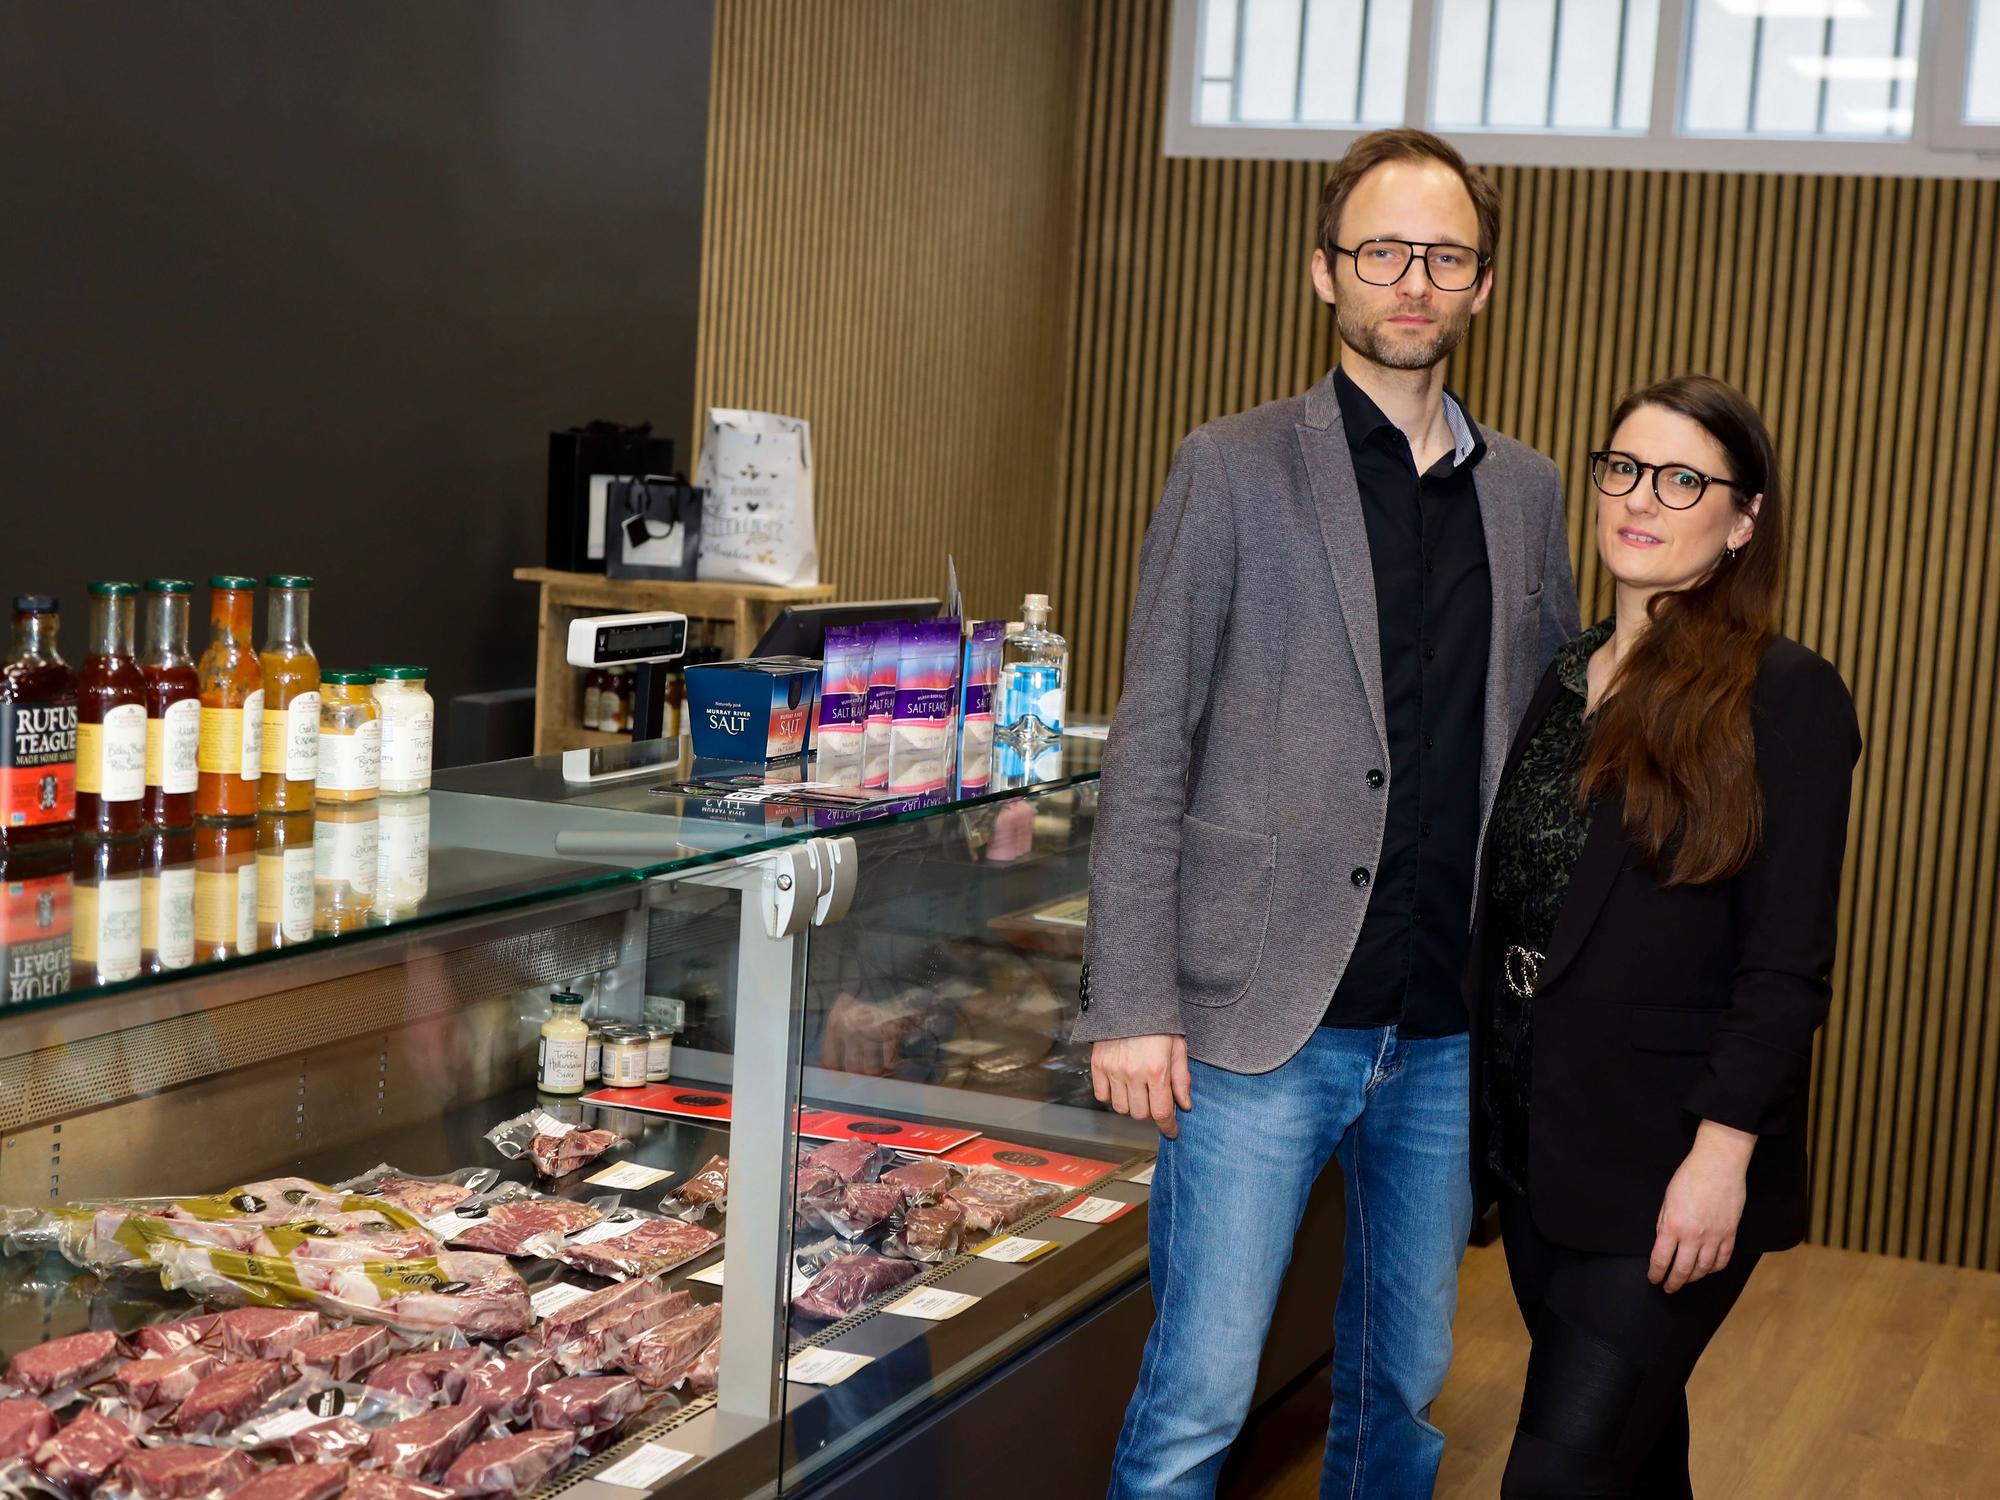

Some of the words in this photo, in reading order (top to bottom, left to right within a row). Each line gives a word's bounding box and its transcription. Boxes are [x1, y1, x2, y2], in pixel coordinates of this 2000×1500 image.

[706, 708, 731, 716] MURRAY
[733, 709, 751, 718] RIVER
[832, 708, 850, 719] SALT
[850, 706, 866, 718] FLAK
[907, 703, 928, 714] SALT
[16, 706, 77, 734] RUFUS
[709, 714, 749, 735] SALT
[780, 718, 801, 738] SALT
[15, 730, 77, 755] TEAGUE
[15, 755, 39, 766] MADE
[553, 1049, 579, 1060] Truffle
